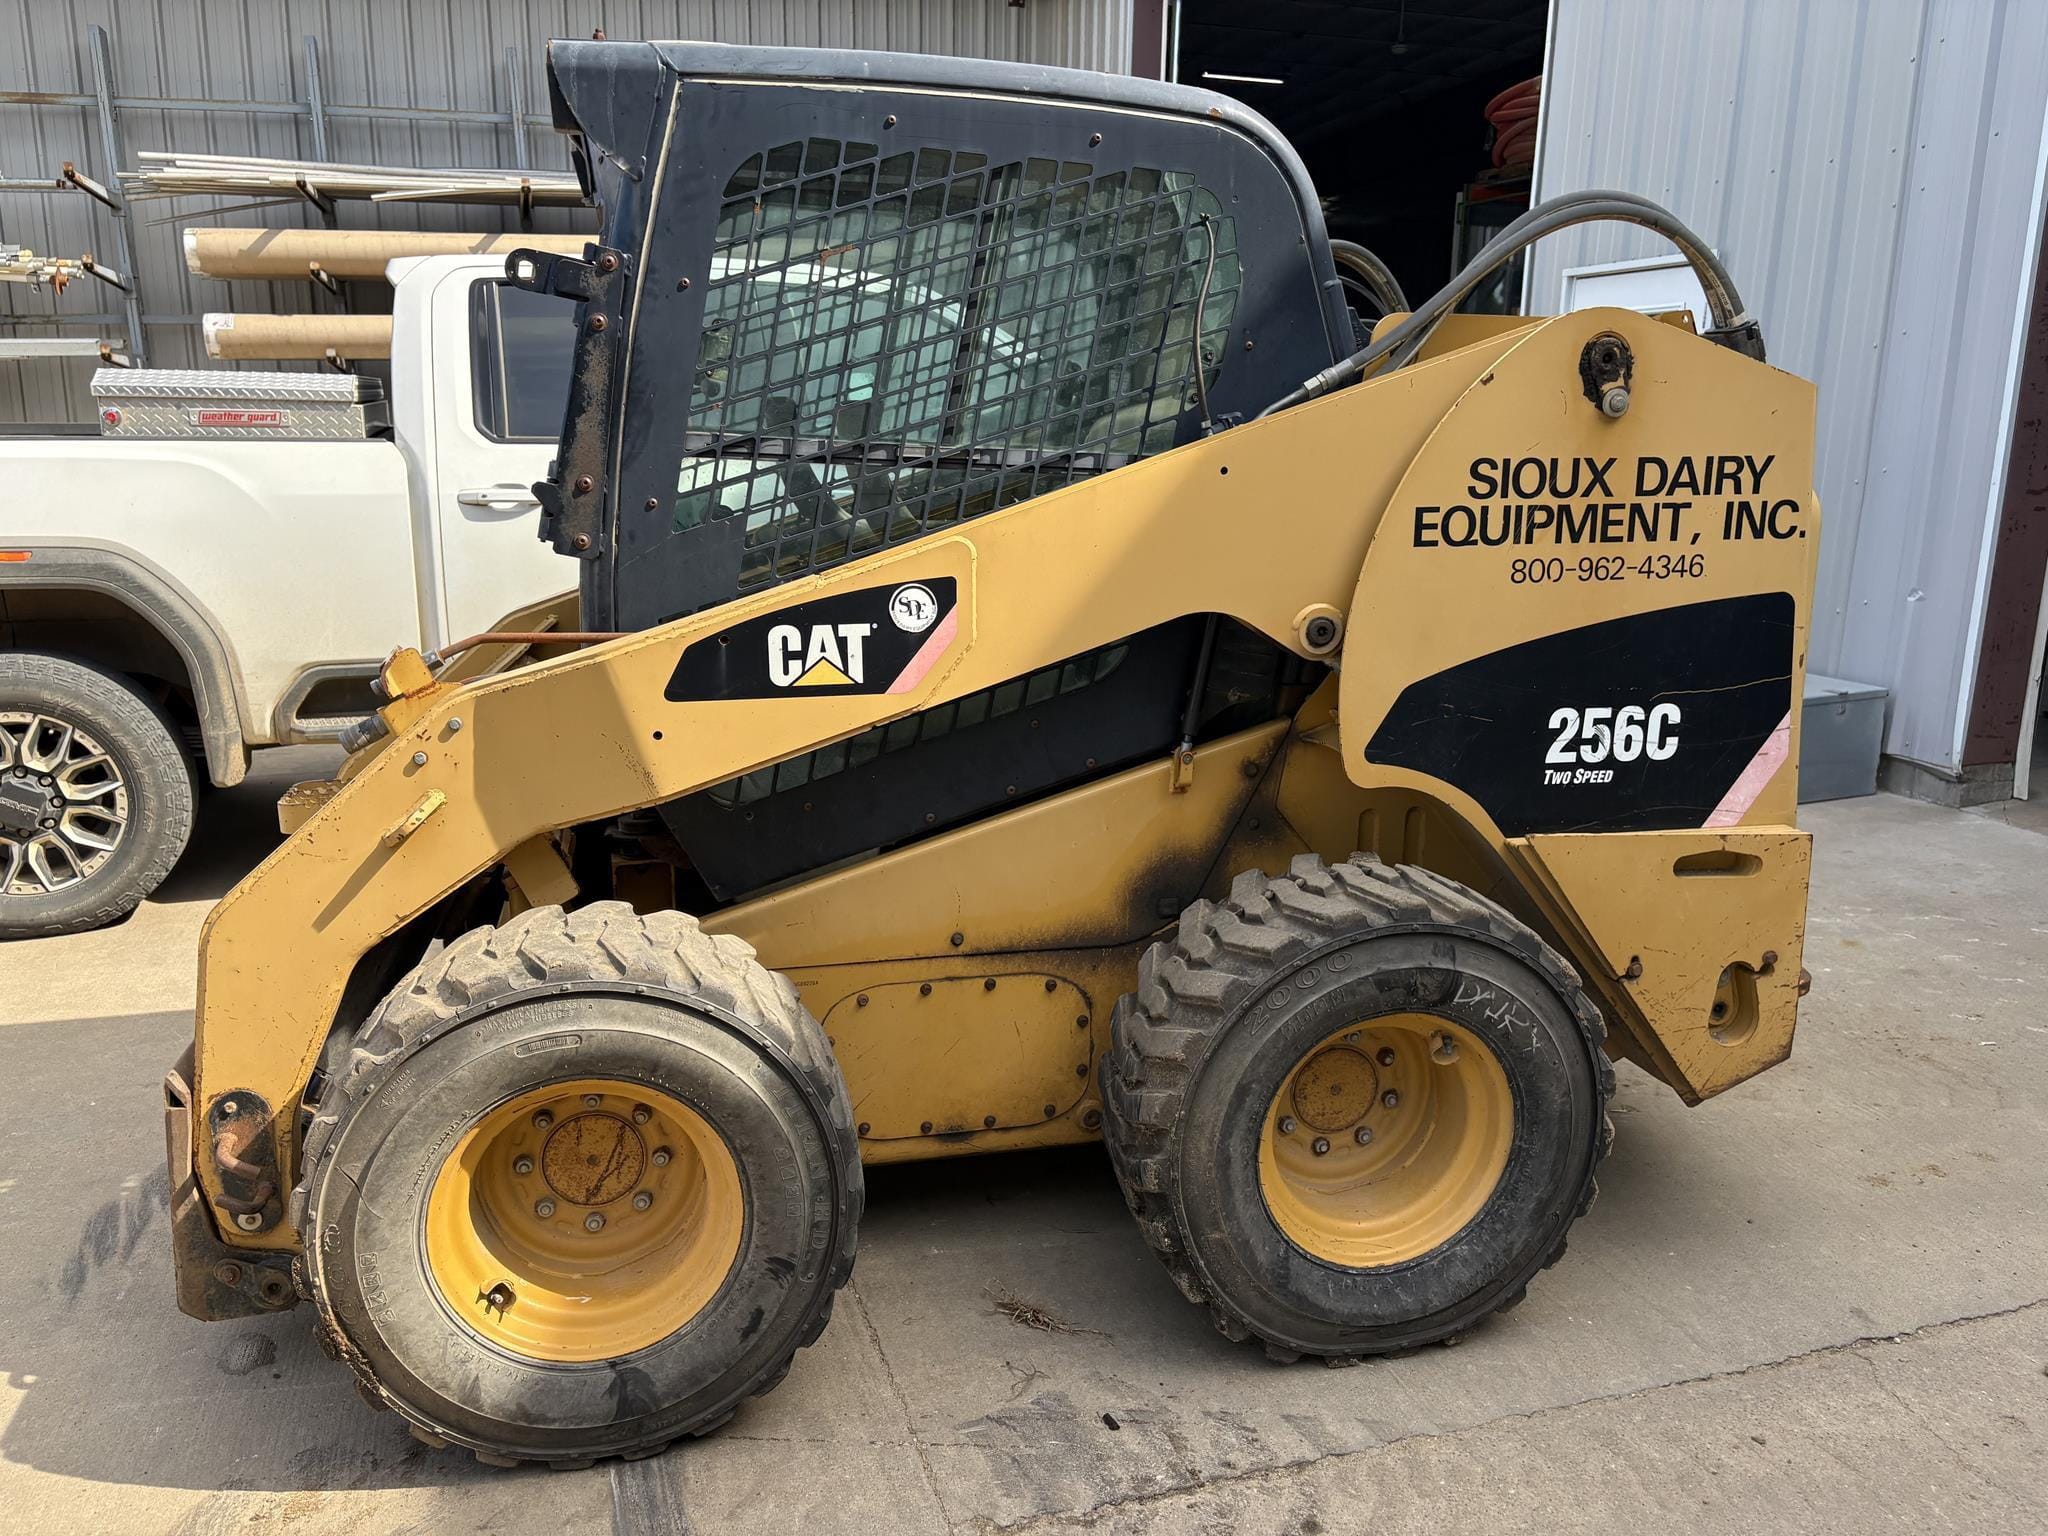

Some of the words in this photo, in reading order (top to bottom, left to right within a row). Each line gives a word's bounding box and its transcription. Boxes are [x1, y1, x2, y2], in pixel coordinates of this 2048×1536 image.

[202, 412, 243, 421] weather
[247, 413, 277, 423] guard
[1467, 457, 1617, 500] SIOUX
[1635, 455, 1776, 497] DAIRY
[1413, 502, 1701, 548] EQUIPMENT,
[1723, 499, 1806, 540] INC.
[1510, 553, 1705, 584] 800-962-4346
[768, 623, 871, 687] CAT
[1545, 702, 1682, 764] 256C
[1243, 951, 1354, 1037] 2000
